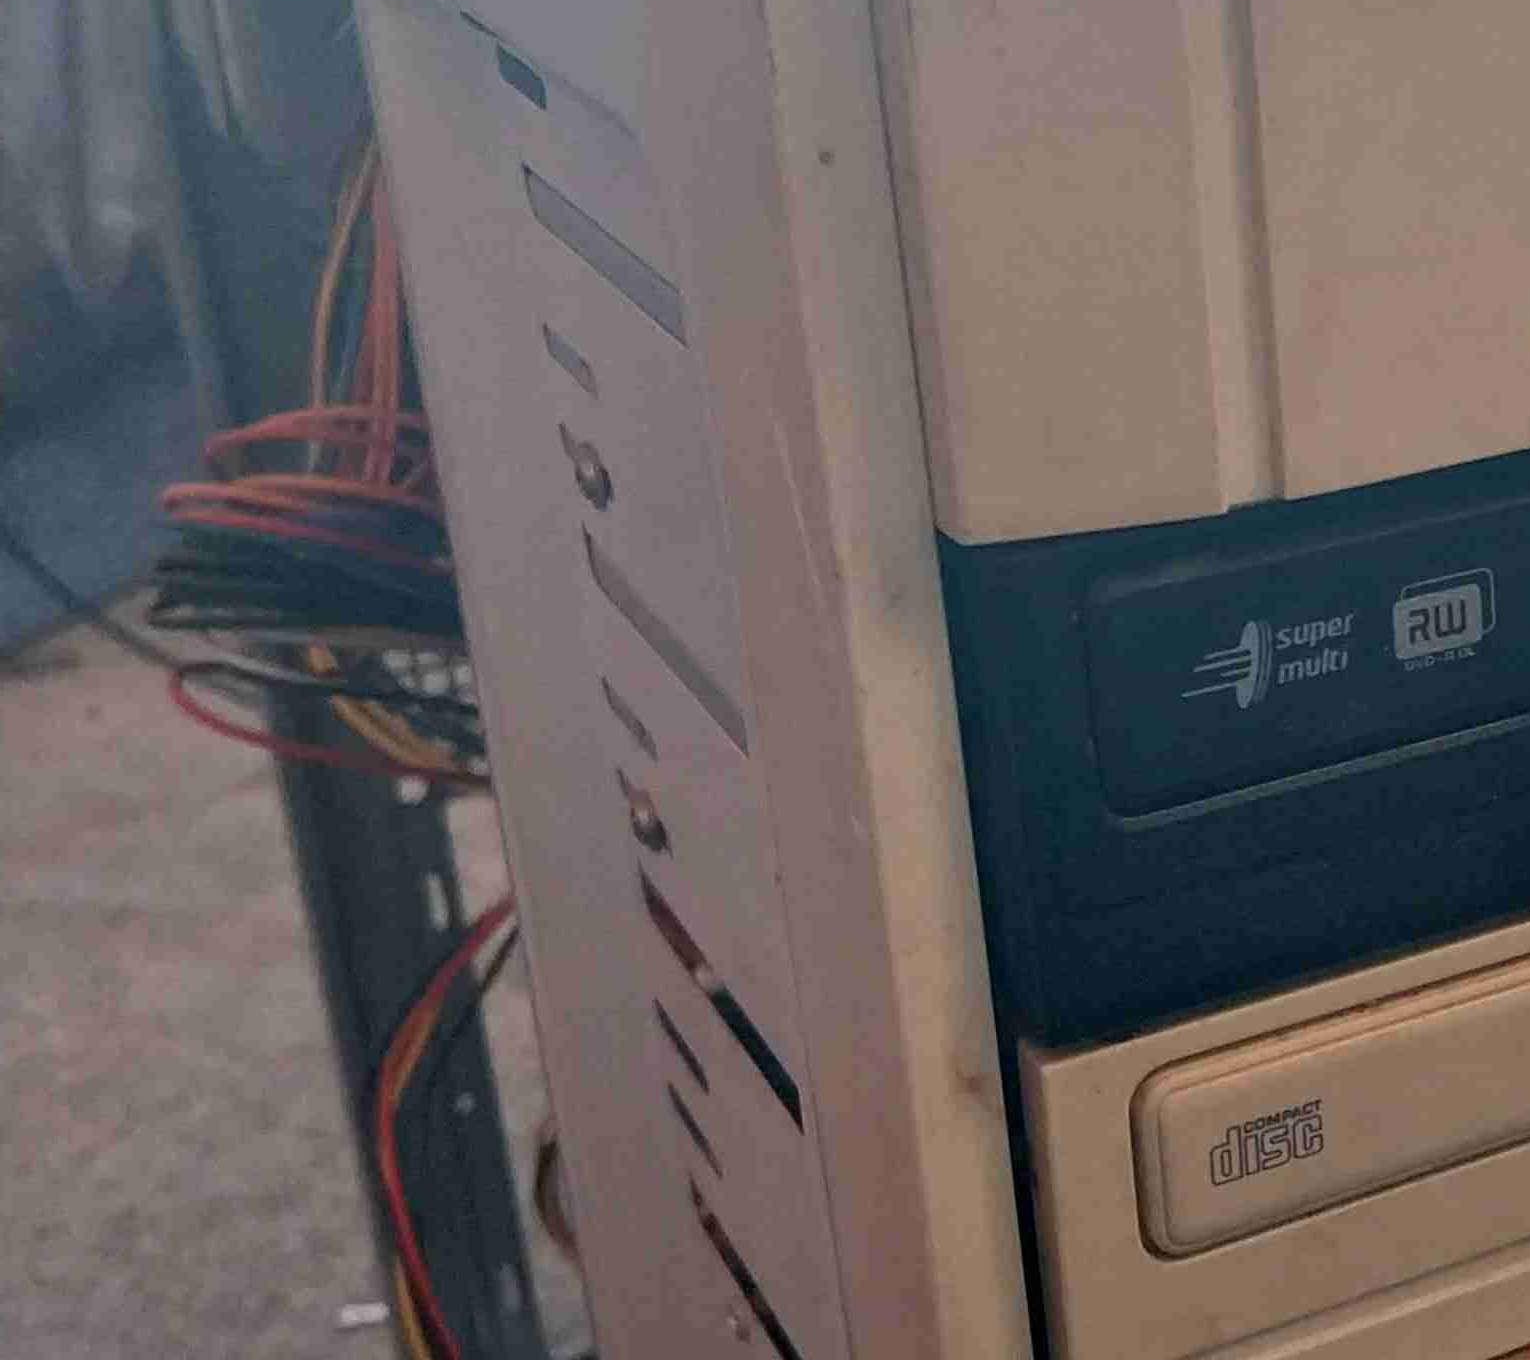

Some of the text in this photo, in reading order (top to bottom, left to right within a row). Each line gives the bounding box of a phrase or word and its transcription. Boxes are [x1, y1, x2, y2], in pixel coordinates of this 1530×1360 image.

[1275, 613, 1355, 650] super
[1408, 599, 1467, 645] RW
[1278, 647, 1349, 685] multi
[1243, 1099, 1323, 1134] COMPACT
[1210, 1114, 1325, 1187] disc
